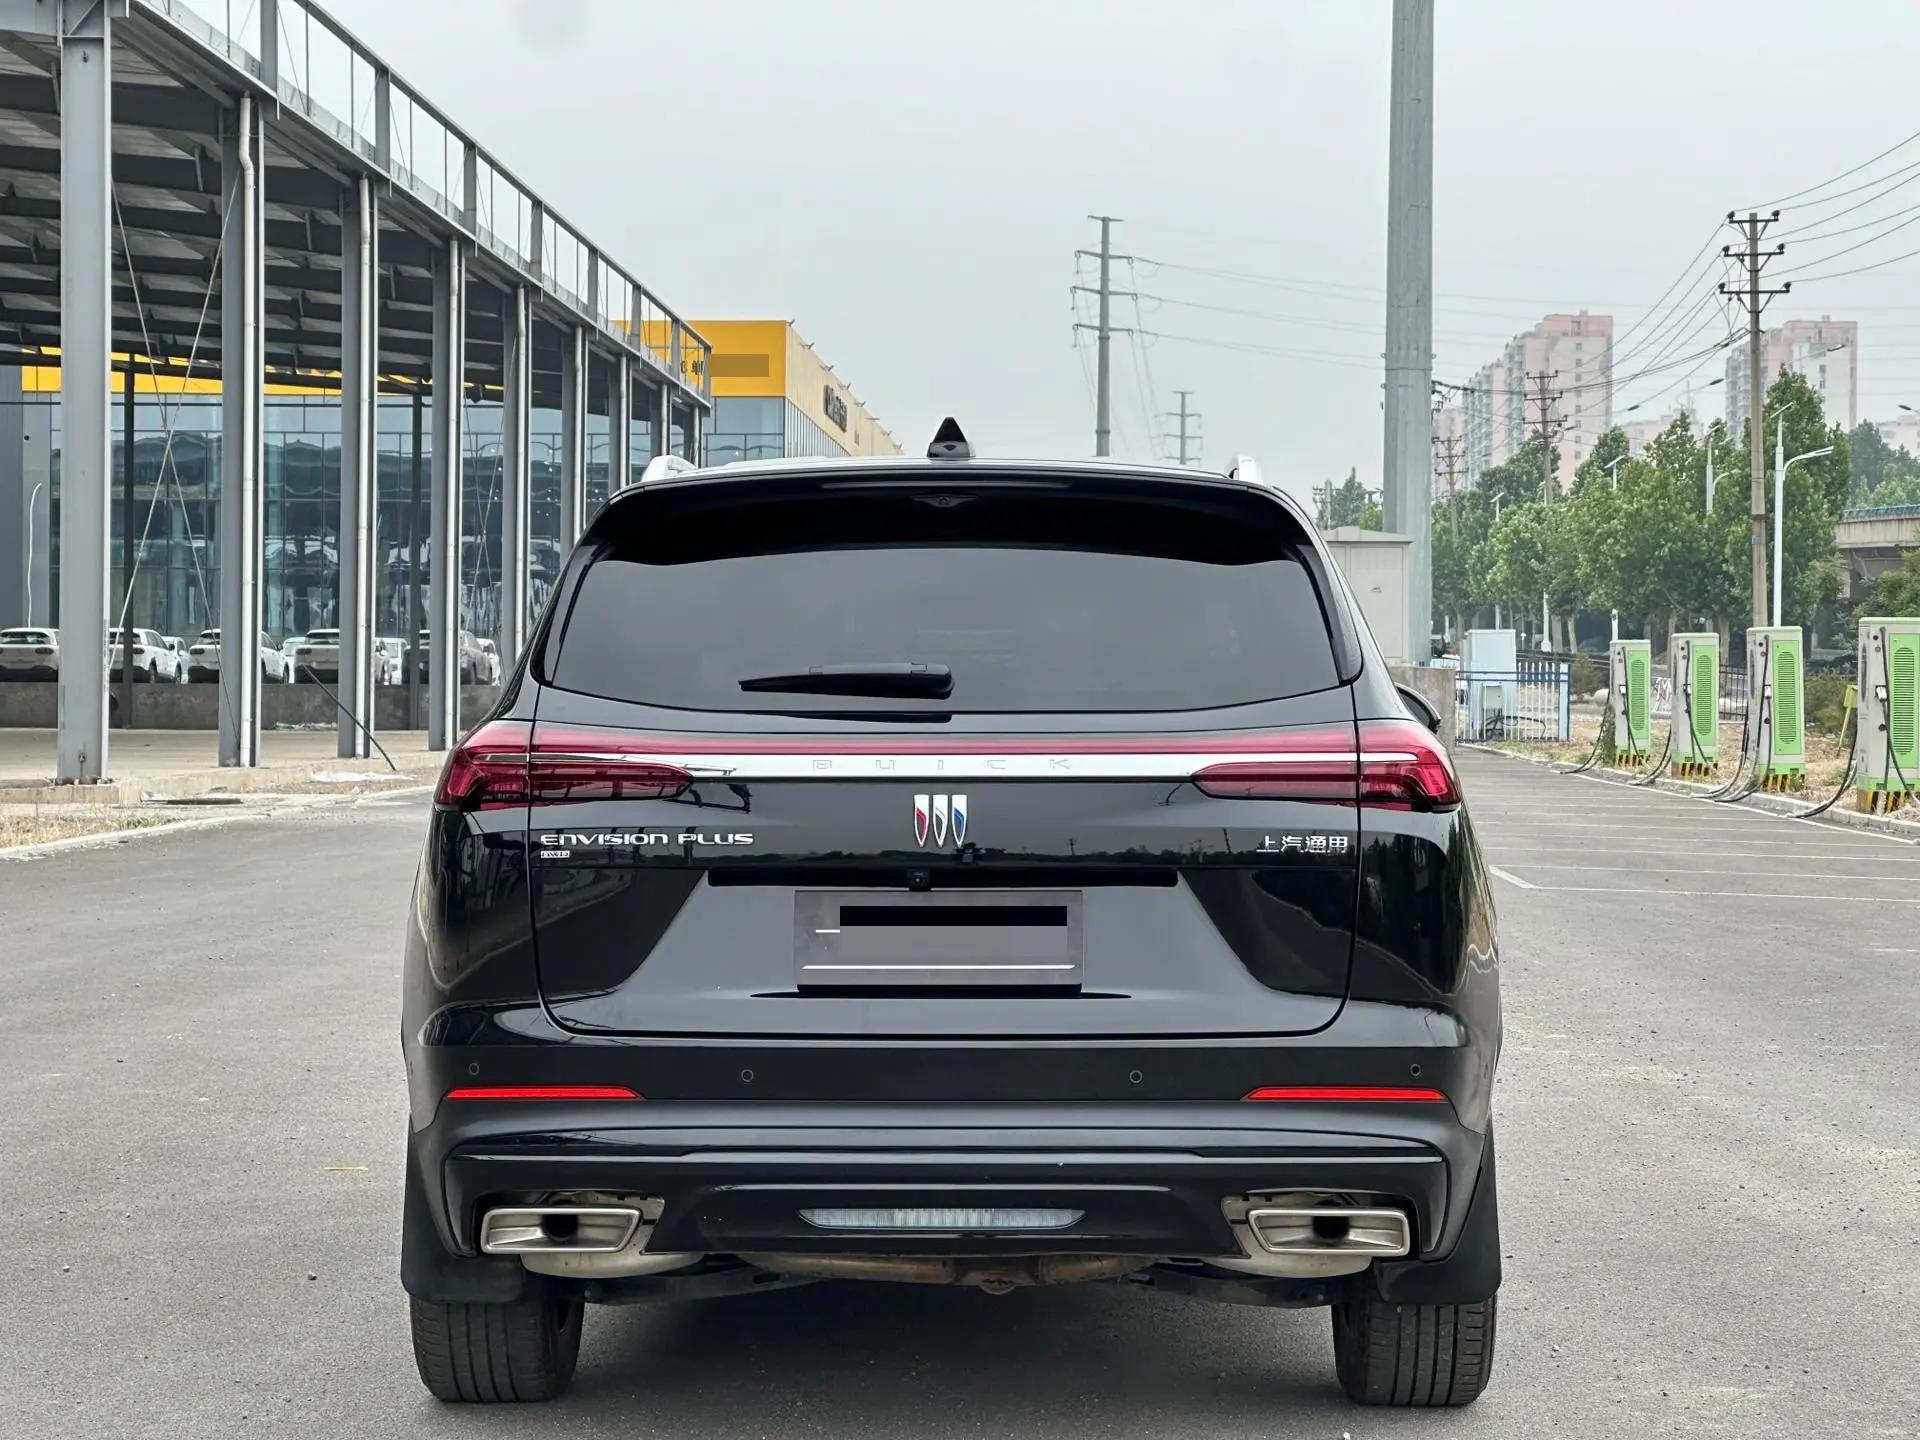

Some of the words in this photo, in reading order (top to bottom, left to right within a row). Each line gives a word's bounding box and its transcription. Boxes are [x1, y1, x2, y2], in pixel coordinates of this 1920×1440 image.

[813, 759, 1070, 771] BUICK
[678, 833, 754, 845] PLUS
[1256, 835, 1348, 853] 上汽通用
